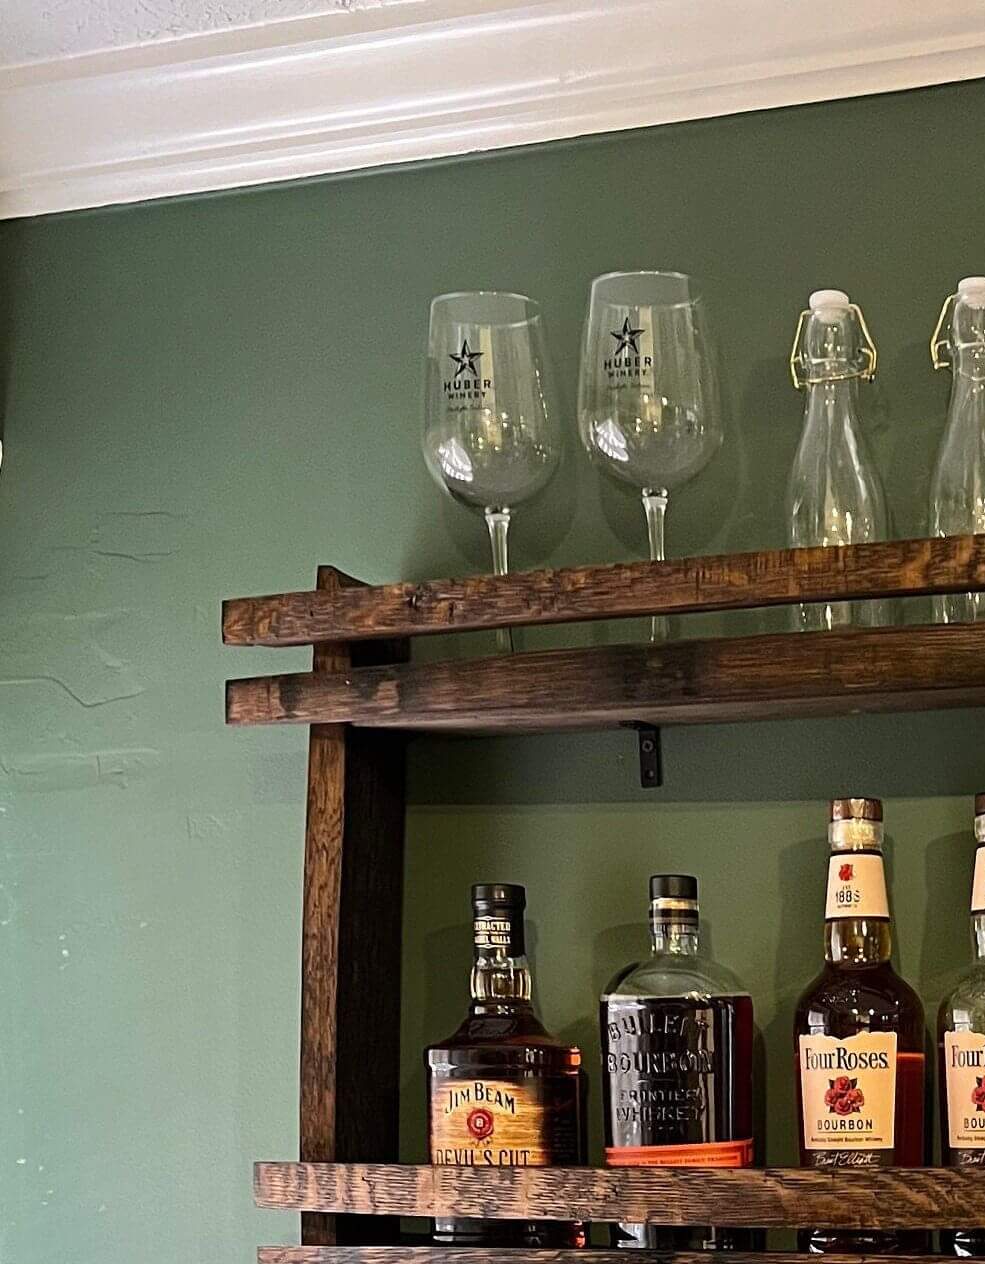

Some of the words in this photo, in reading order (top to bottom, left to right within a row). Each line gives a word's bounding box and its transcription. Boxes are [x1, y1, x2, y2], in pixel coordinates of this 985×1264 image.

[603, 356, 652, 370] HUBER
[608, 368, 646, 378] WINERY
[443, 379, 491, 392] HUBER
[448, 391, 486, 400] WINERY
[607, 1049, 715, 1074] BOURBON
[445, 1088, 470, 1114] JIM
[475, 1082, 516, 1115] BEAM
[817, 1119, 873, 1130] BOURBON
[500, 1149, 530, 1166] CUT
